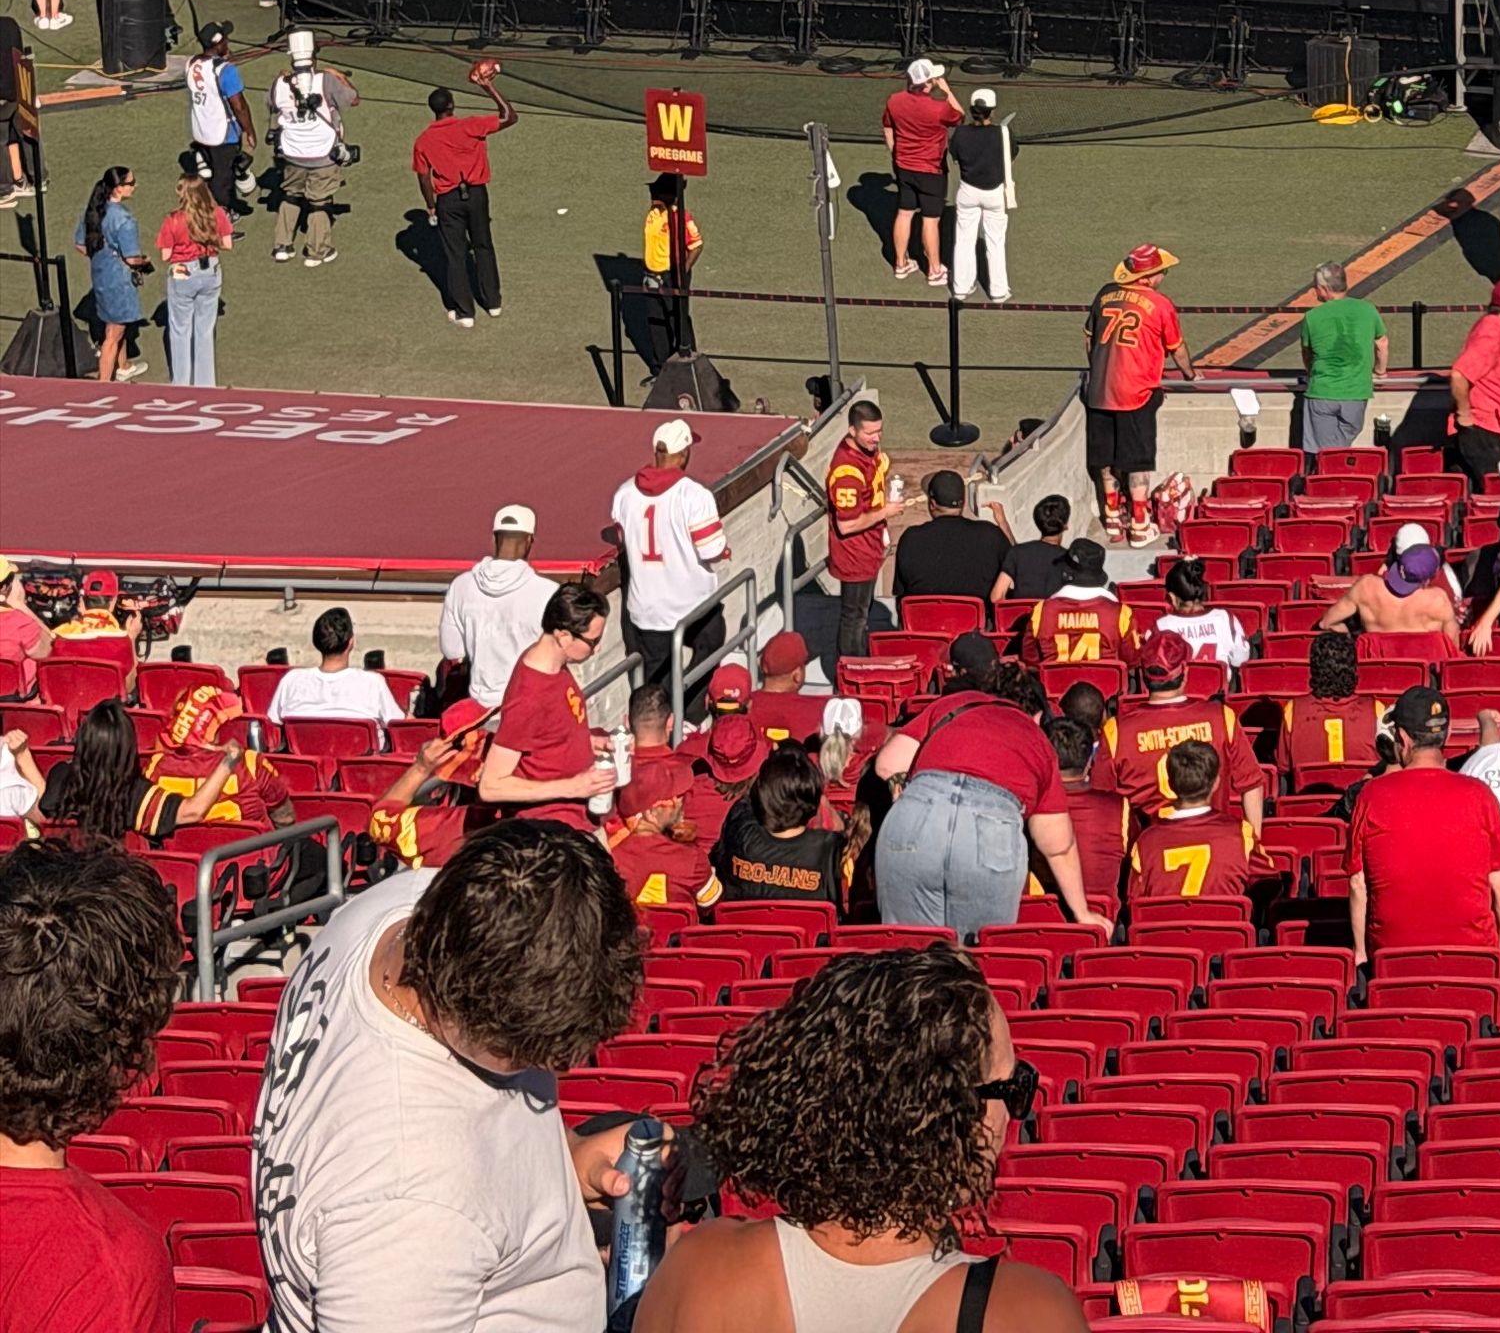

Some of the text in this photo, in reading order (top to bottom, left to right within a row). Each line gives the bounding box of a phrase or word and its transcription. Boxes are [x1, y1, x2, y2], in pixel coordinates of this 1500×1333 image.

[657, 102, 694, 142] W
[650, 145, 705, 164] PREGAME
[66, 394, 459, 426] RESORT
[835, 487, 858, 508] 55
[641, 503, 662, 562] 1
[1057, 610, 1100, 630] MAIAVA
[1054, 632, 1101, 661] 14
[1136, 721, 1213, 751] SMITH-SCHUSTER
[1323, 718, 1345, 763] 1
[732, 855, 822, 893] TROJANS
[1162, 844, 1212, 896] 7
